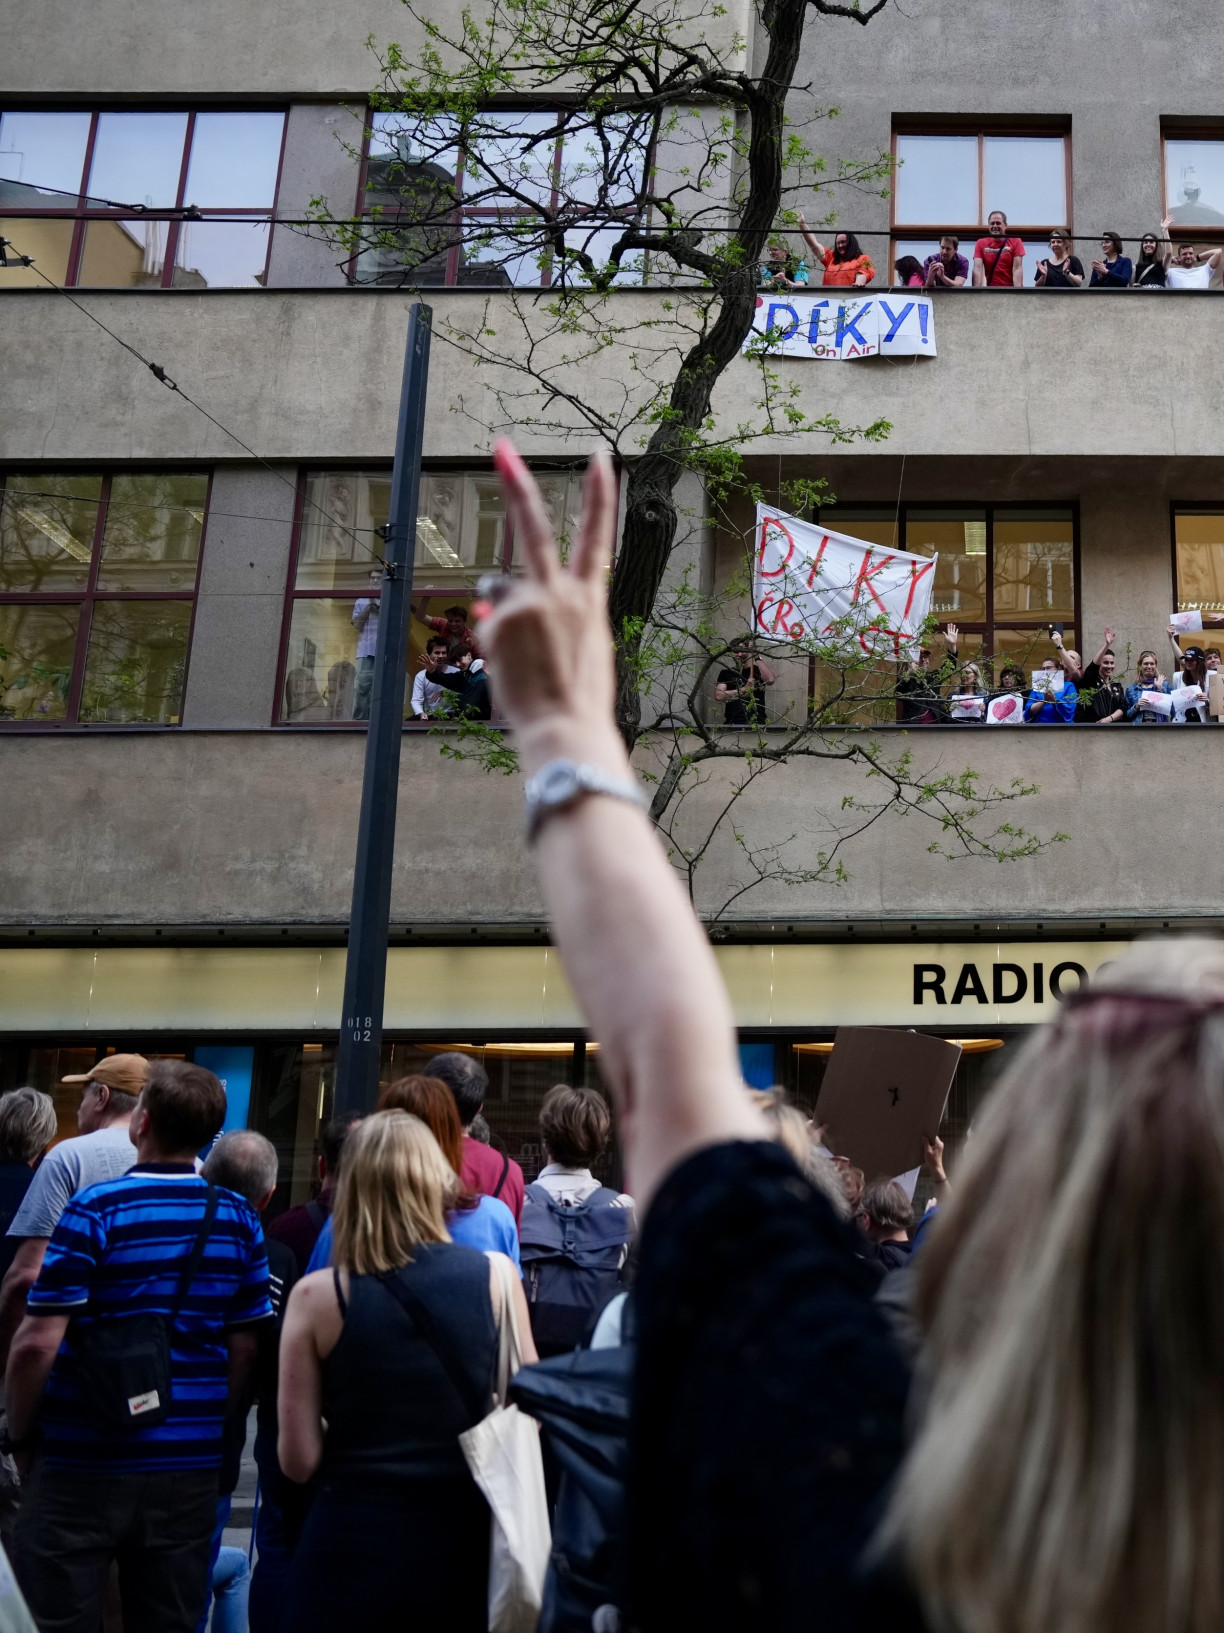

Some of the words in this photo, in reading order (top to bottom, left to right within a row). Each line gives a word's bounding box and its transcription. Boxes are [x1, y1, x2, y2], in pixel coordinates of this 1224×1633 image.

[766, 300, 928, 348] DÍKY!
[815, 344, 836, 358] On
[846, 344, 876, 357] Air
[912, 961, 1117, 1005] RADIO
